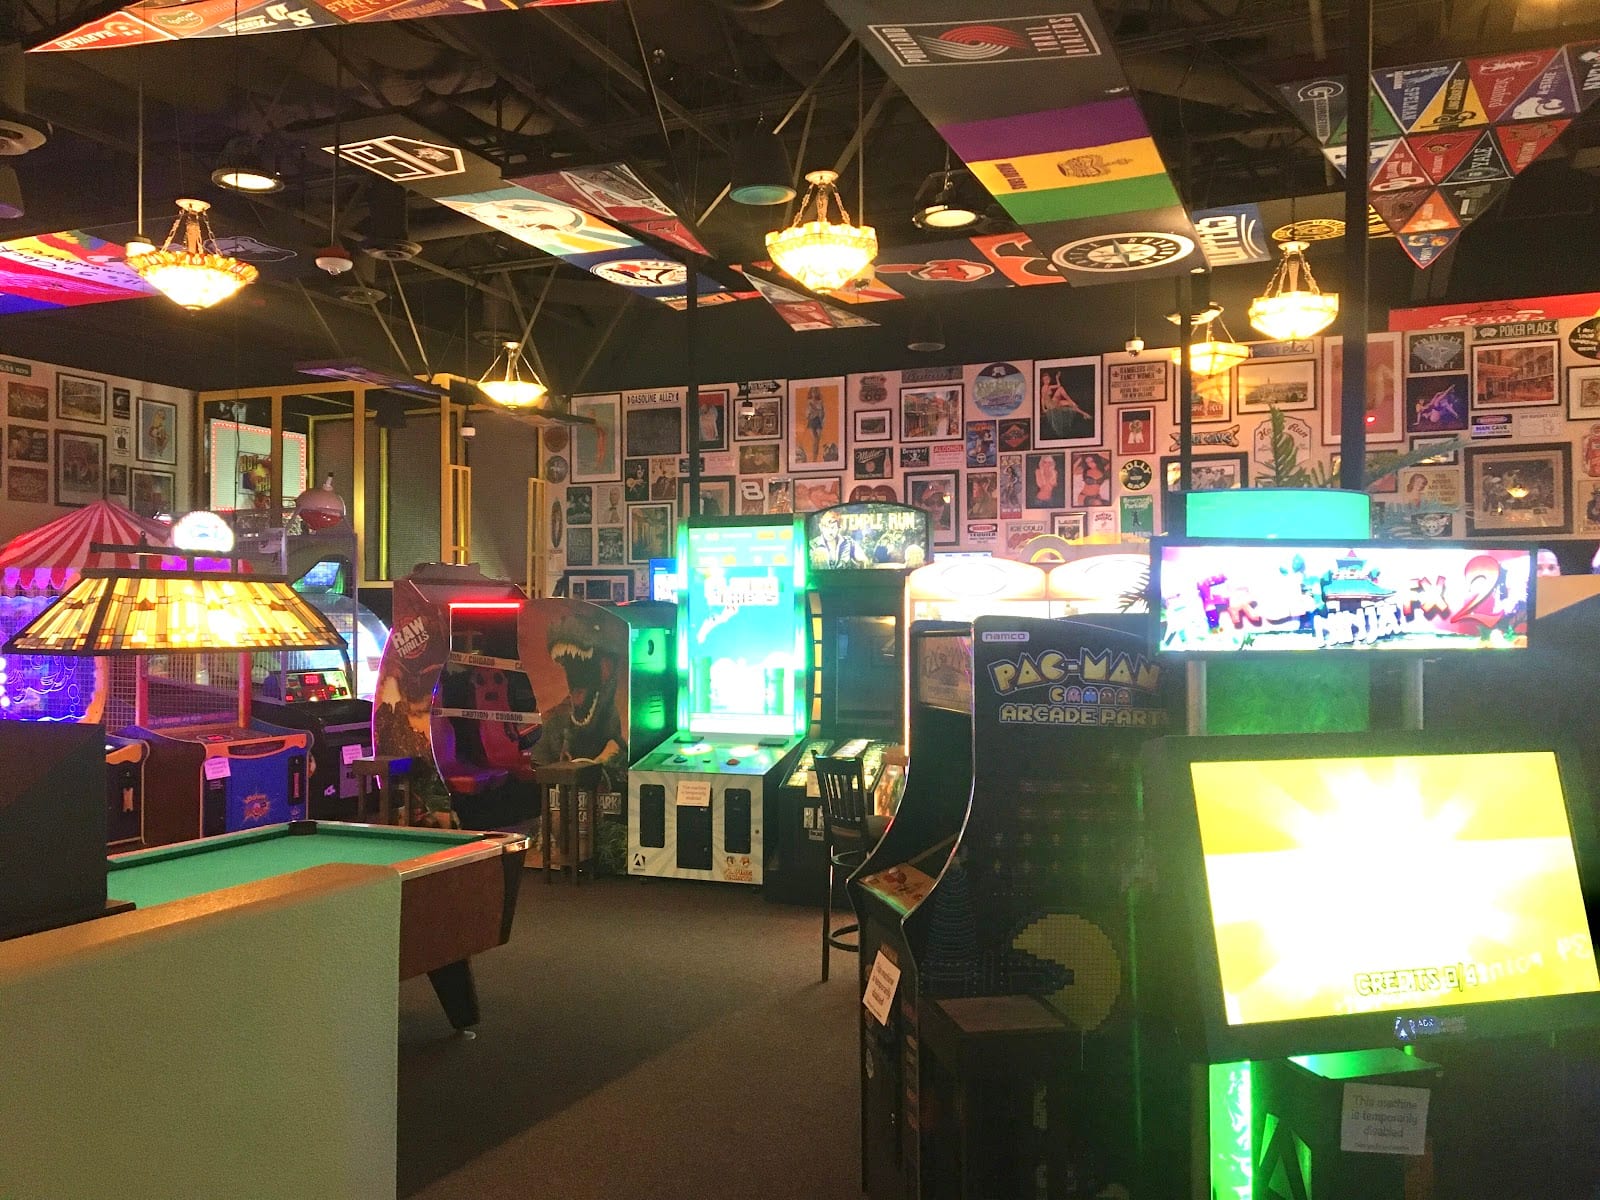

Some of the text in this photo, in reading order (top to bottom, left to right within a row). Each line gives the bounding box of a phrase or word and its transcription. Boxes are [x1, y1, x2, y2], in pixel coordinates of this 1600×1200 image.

[881, 28, 930, 64] PORTLAND
[1025, 25, 1061, 52] TRAIL
[1048, 16, 1090, 54] BLAZERS
[1402, 86, 1420, 120] SPELMAN
[1488, 77, 1513, 109] Stanford
[1472, 147, 1493, 170] YALE
[1500, 322, 1553, 337] POKER PLACE
[631, 392, 675, 404] GASOLINE ALLEY
[1288, 423, 1308, 439] Run
[741, 482, 765, 501] 8
[841, 511, 915, 531] TEMPLE RUN
[391, 616, 426, 650] RAW
[985, 633, 1026, 641] namco
[1314, 601, 1399, 647] NINJA
[397, 630, 430, 659] THRILLS
[989, 649, 1161, 694] PAC-MAN
[1001, 703, 1163, 726] ARCADE PART
[1353, 967, 1442, 997] CREDITS
